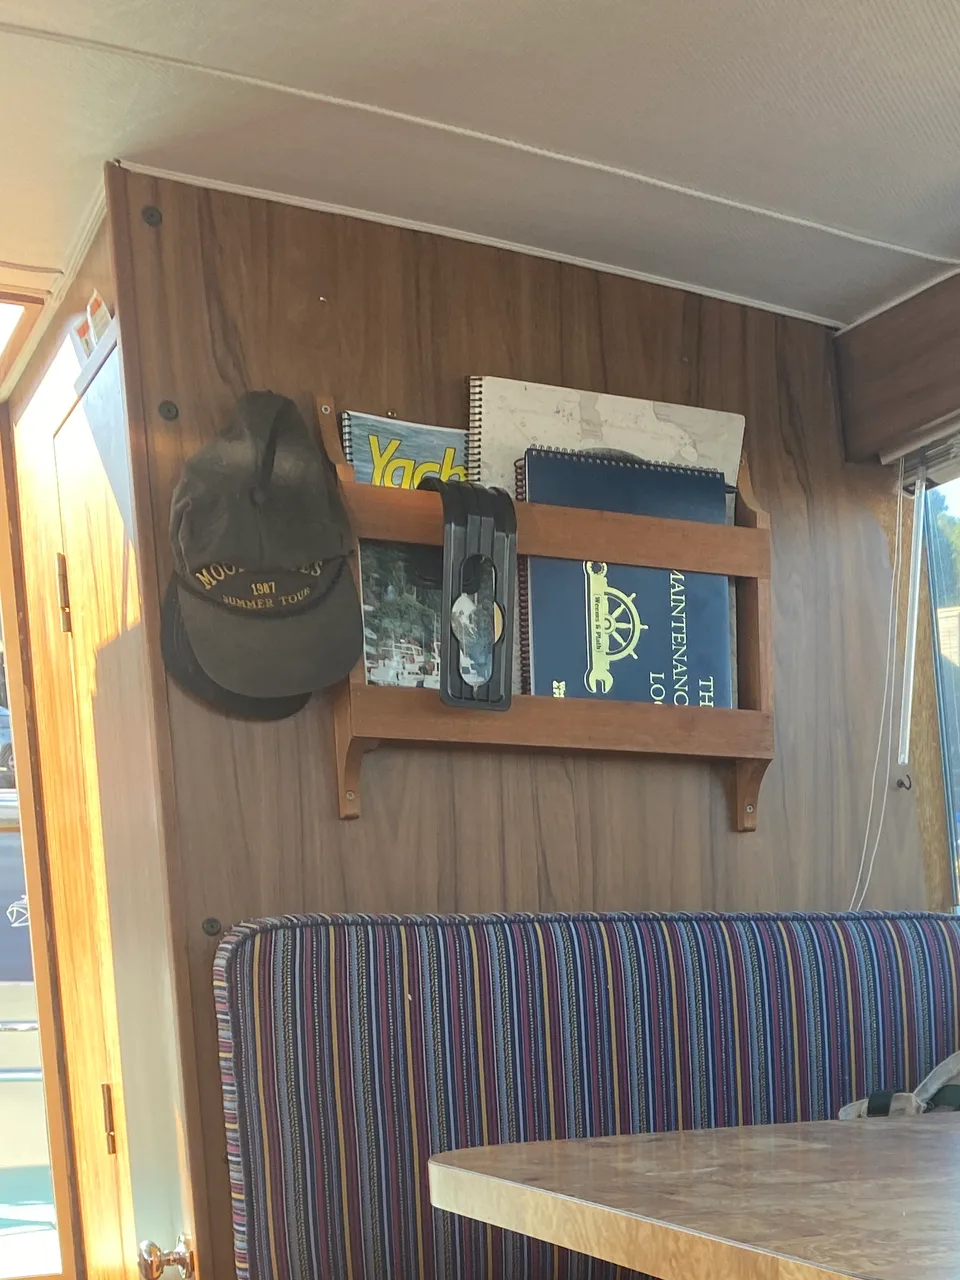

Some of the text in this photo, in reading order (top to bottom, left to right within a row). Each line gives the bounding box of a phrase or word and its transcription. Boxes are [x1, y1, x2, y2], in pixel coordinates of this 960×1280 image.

[222, 587, 311, 609] SUMMER TOUR
[251, 582, 276, 595] 1987
[650, 671, 666, 704] LO
[699, 676, 714, 707] TH
